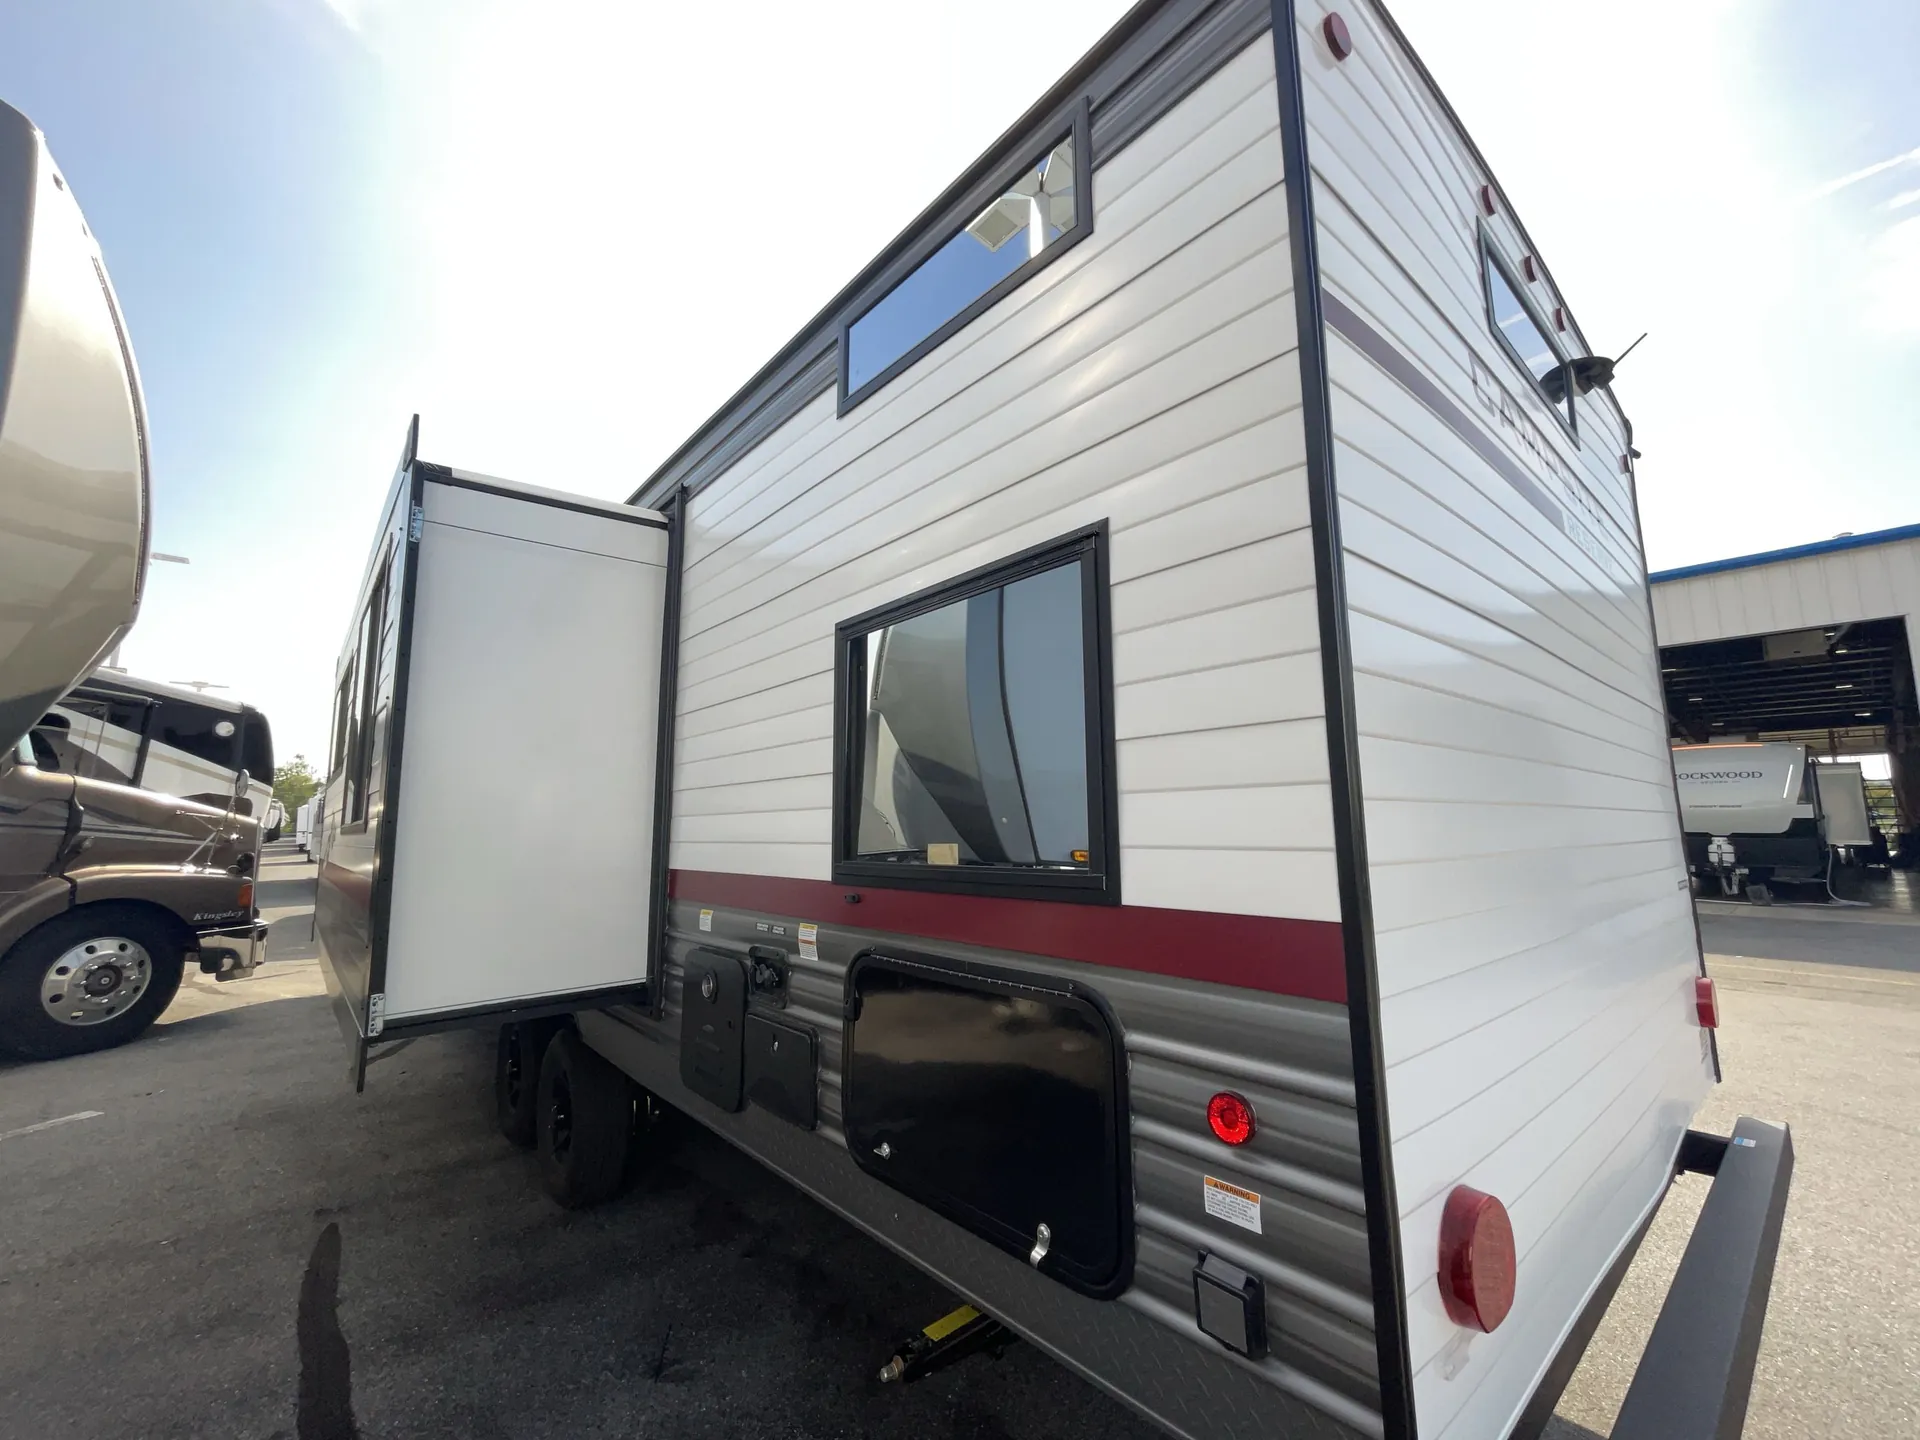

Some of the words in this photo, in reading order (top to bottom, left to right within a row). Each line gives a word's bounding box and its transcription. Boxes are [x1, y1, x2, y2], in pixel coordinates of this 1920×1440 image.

[1676, 771, 1763, 780] OCKWOOD
[193, 910, 244, 920] Kingsley
[1220, 1182, 1250, 1200] WARNING
